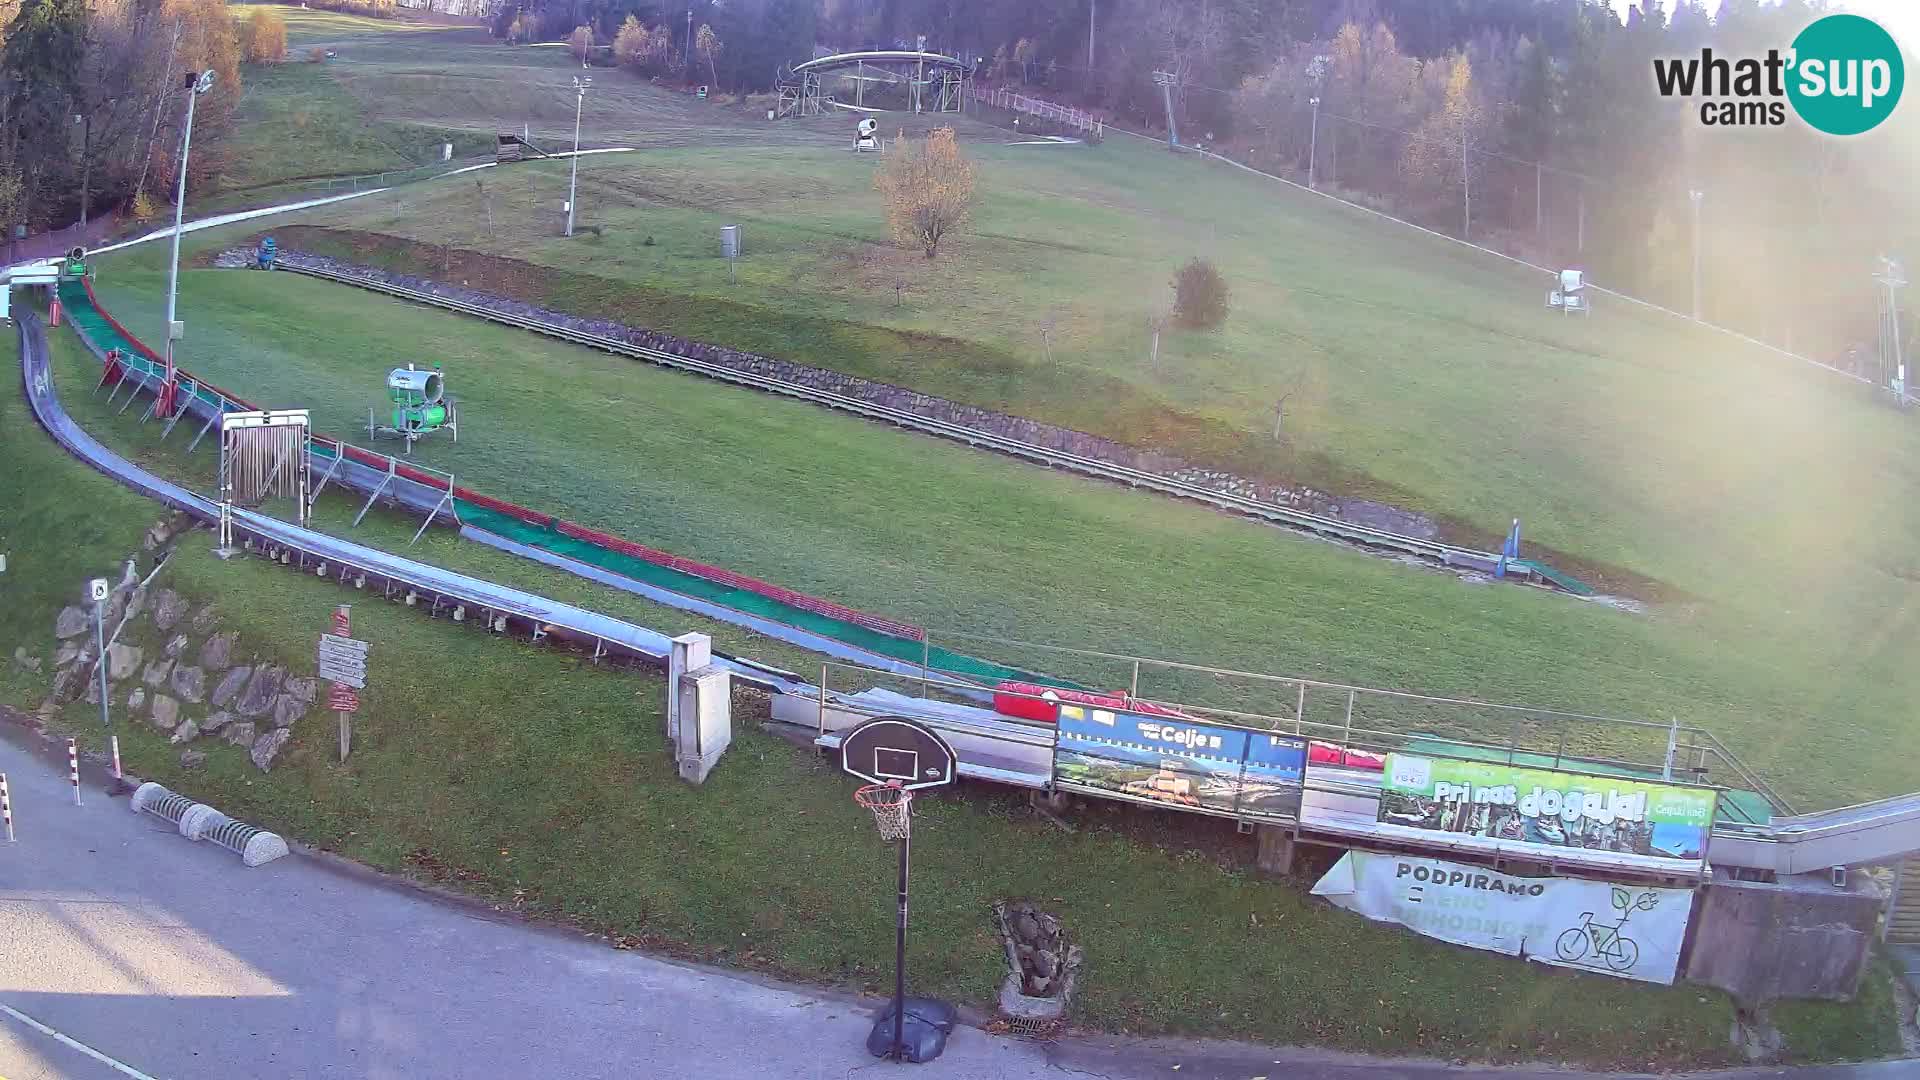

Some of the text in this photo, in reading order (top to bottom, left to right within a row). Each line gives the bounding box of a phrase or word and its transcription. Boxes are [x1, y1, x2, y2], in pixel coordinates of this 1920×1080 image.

[1161, 726, 1207, 749] Celje
[1434, 780, 1471, 803] Pri
[1474, 785, 1518, 806] nas
[1519, 786, 1648, 825] dogaja!
[1396, 862, 1545, 897] PODPIRAMO
